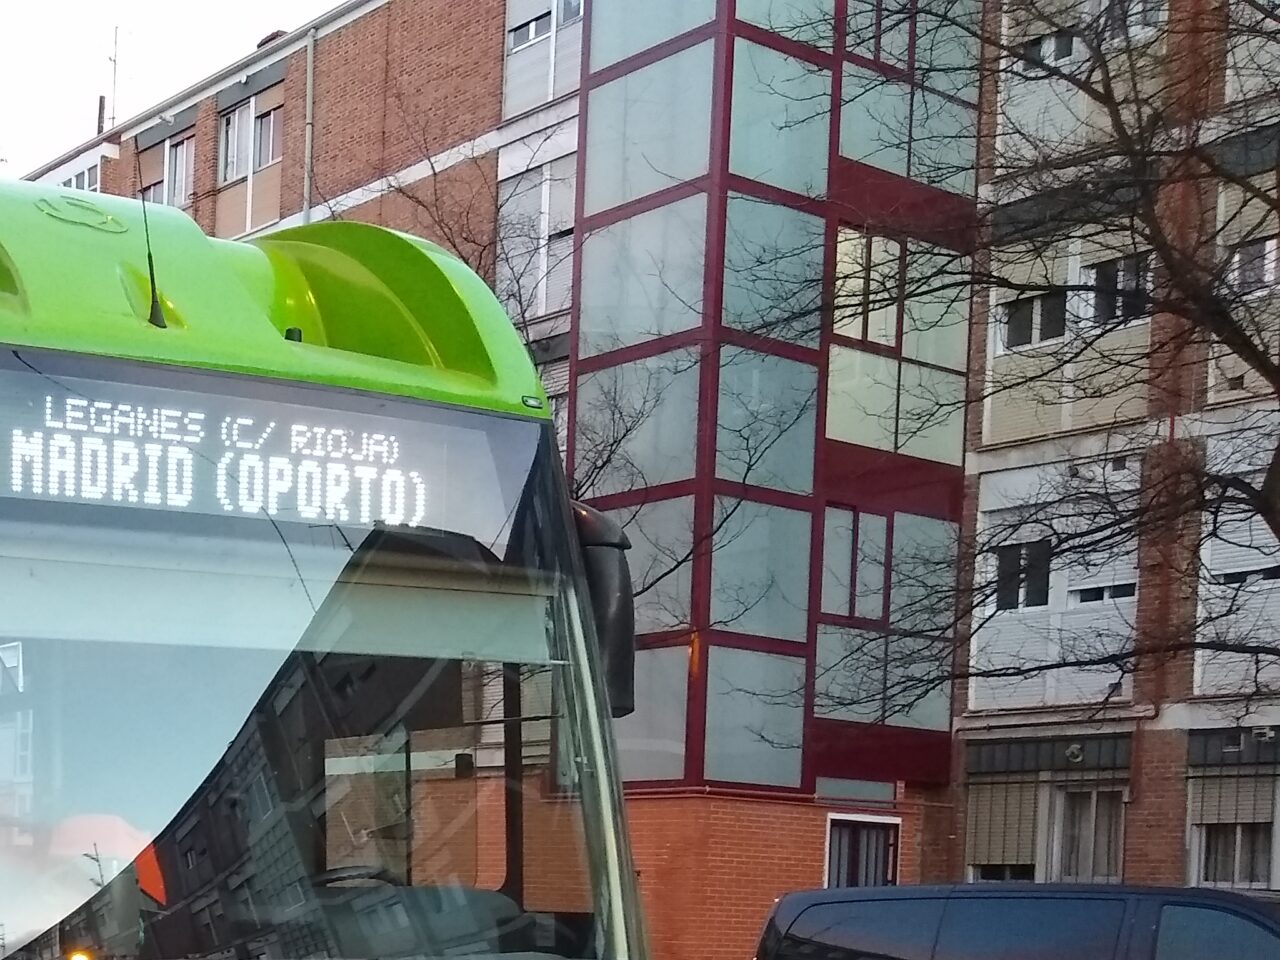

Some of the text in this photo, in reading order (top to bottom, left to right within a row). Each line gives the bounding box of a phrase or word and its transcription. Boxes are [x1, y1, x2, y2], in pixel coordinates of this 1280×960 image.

[46, 395, 400, 464] LEGANES (C/ RIOJA)
[11, 428, 427, 527] MADRID (OPORTO)
